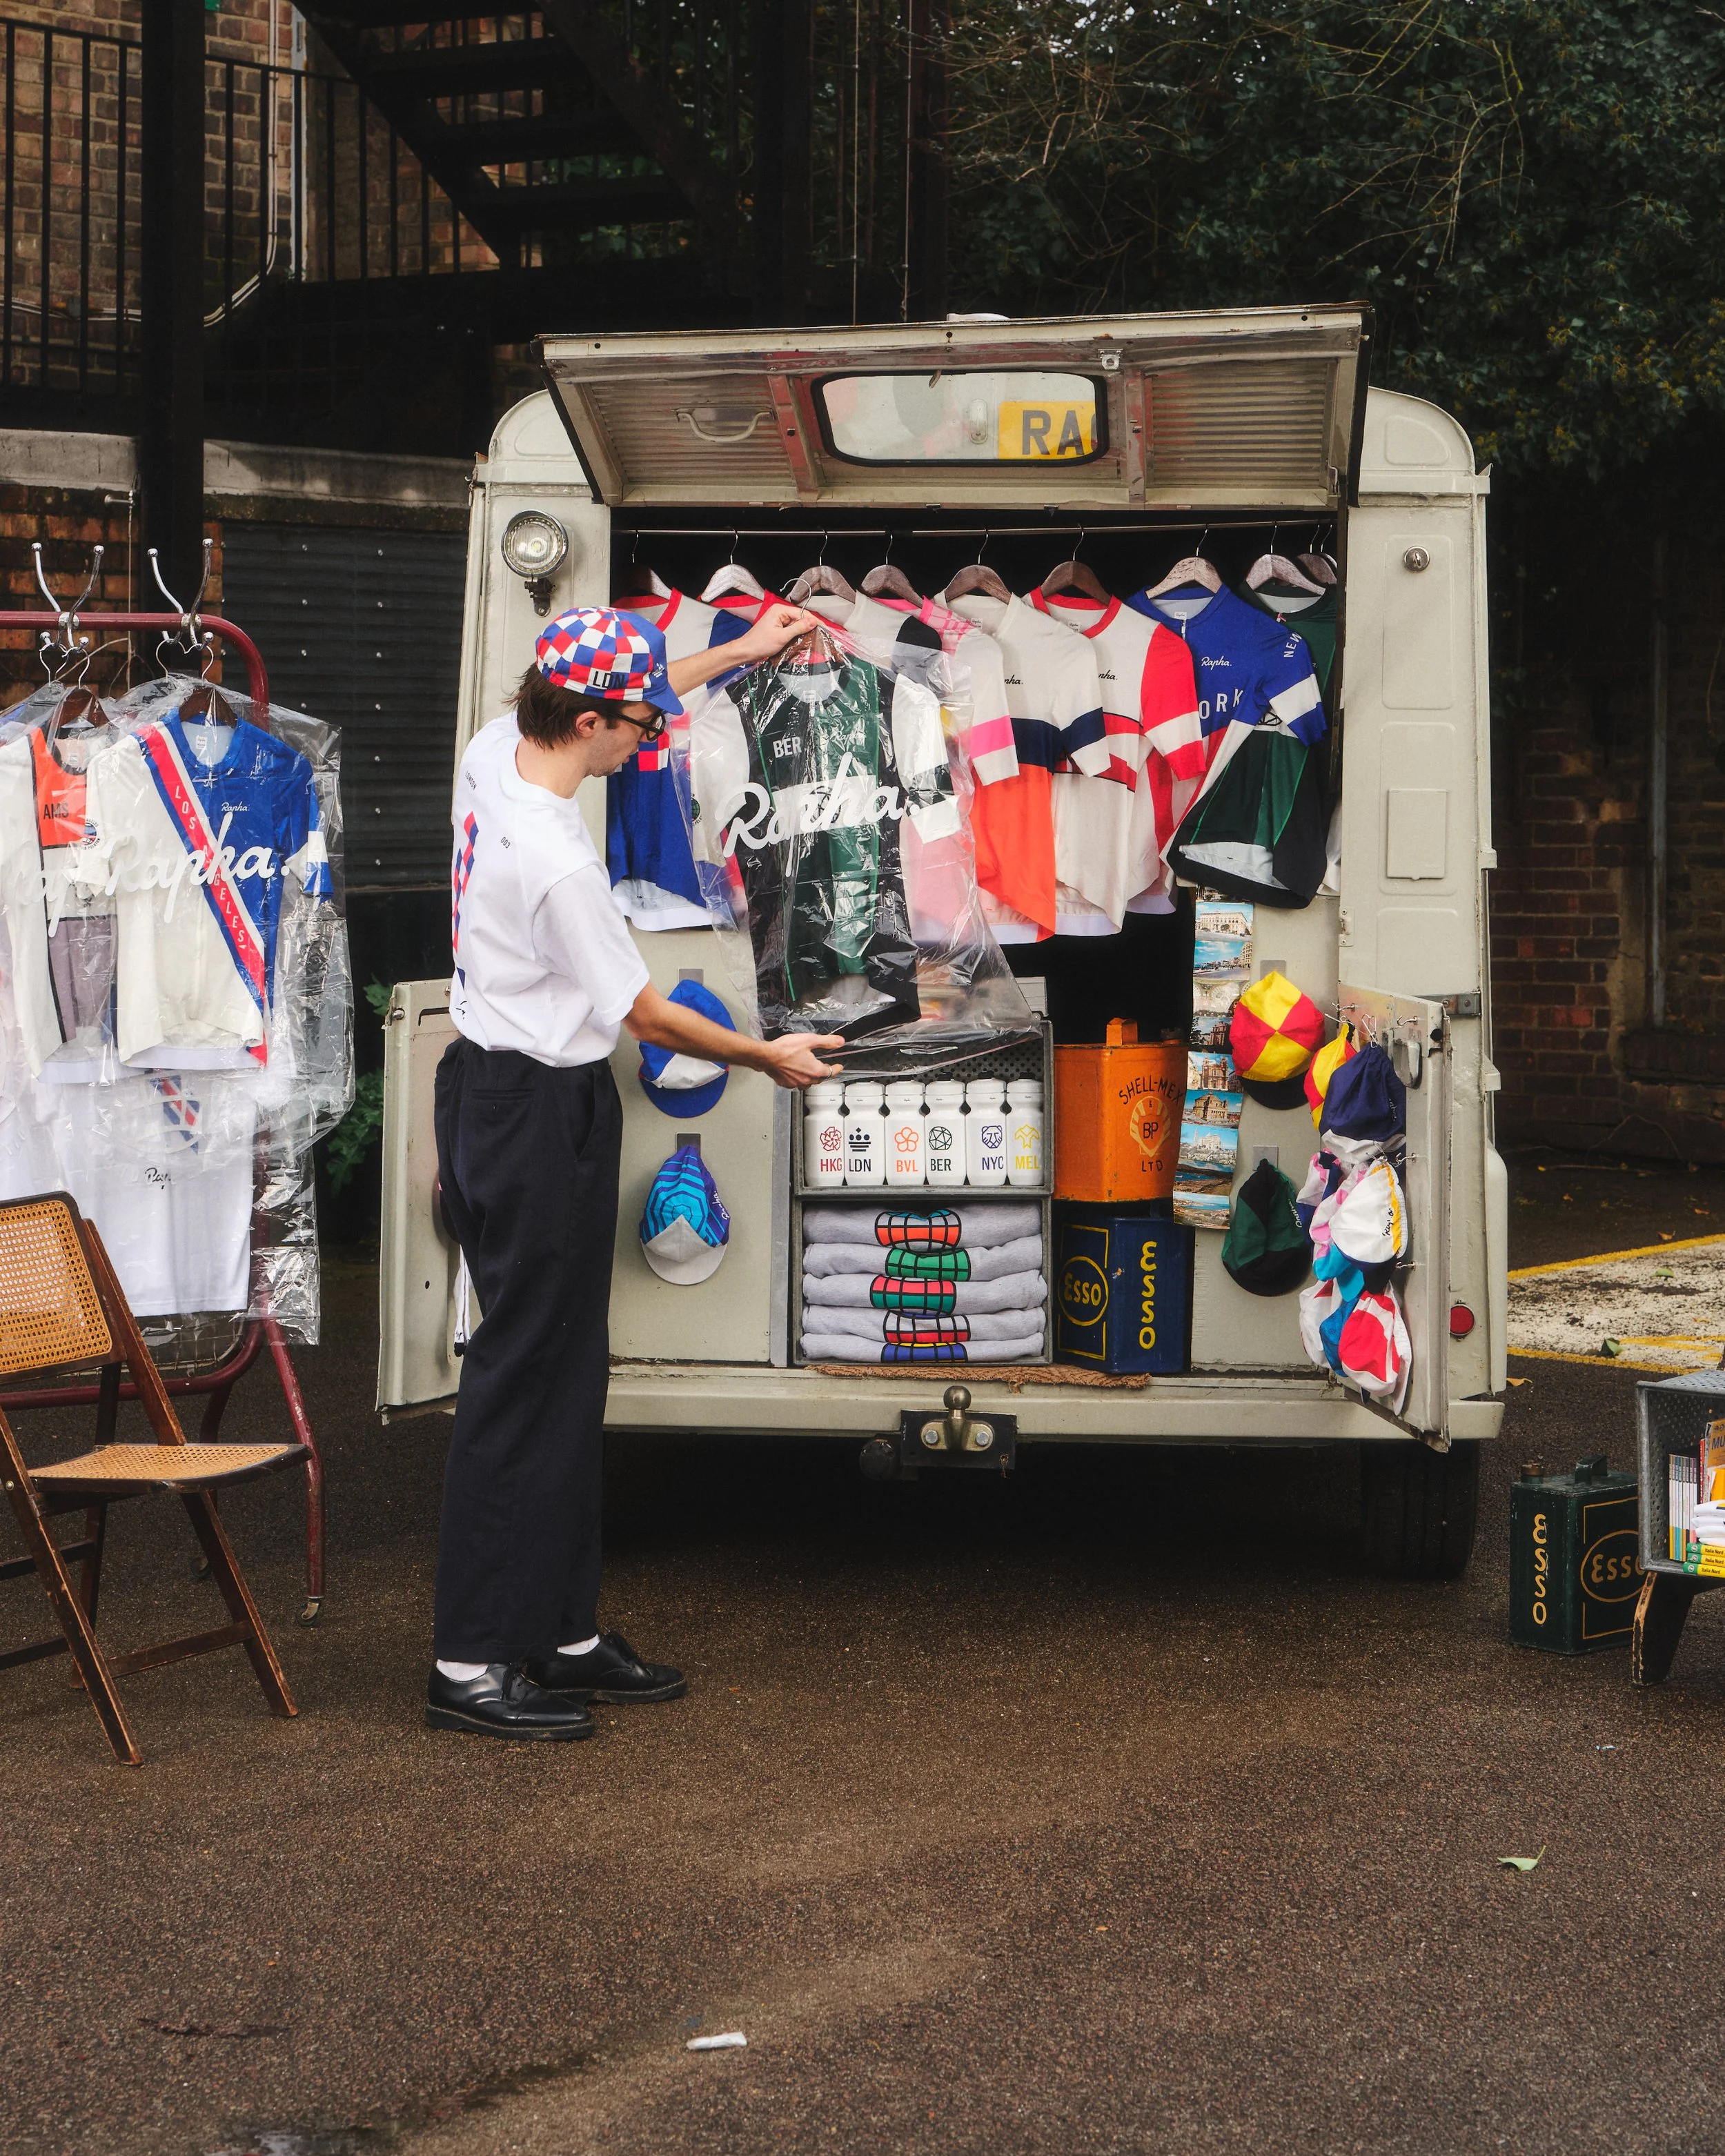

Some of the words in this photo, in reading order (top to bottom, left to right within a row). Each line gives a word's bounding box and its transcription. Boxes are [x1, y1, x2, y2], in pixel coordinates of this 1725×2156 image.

[1022, 410, 1098, 455] RA
[1283, 632, 1302, 657] NEW
[1201, 655, 1232, 671] Rapha.
[593, 671, 625, 689] LDN
[1199, 689, 1243, 720] ORK
[772, 735, 802, 759] BER
[43, 802, 69, 820] AMS
[500, 836, 511, 849] 003
[175, 785, 196, 830] LOS
[203, 845, 245, 943] AGELES
[1118, 1075, 1184, 1105] SHELL-MEX
[1143, 1122, 1159, 1140] BP
[820, 1158, 842, 1172] HKG
[849, 1158, 871, 1172] LDN
[896, 1160, 918, 1172] BVL
[930, 1158, 952, 1171] BER
[982, 1156, 1004, 1171] NYC
[1015, 1156, 1041, 1169] MEL
[1141, 1160, 1163, 1172] LTD
